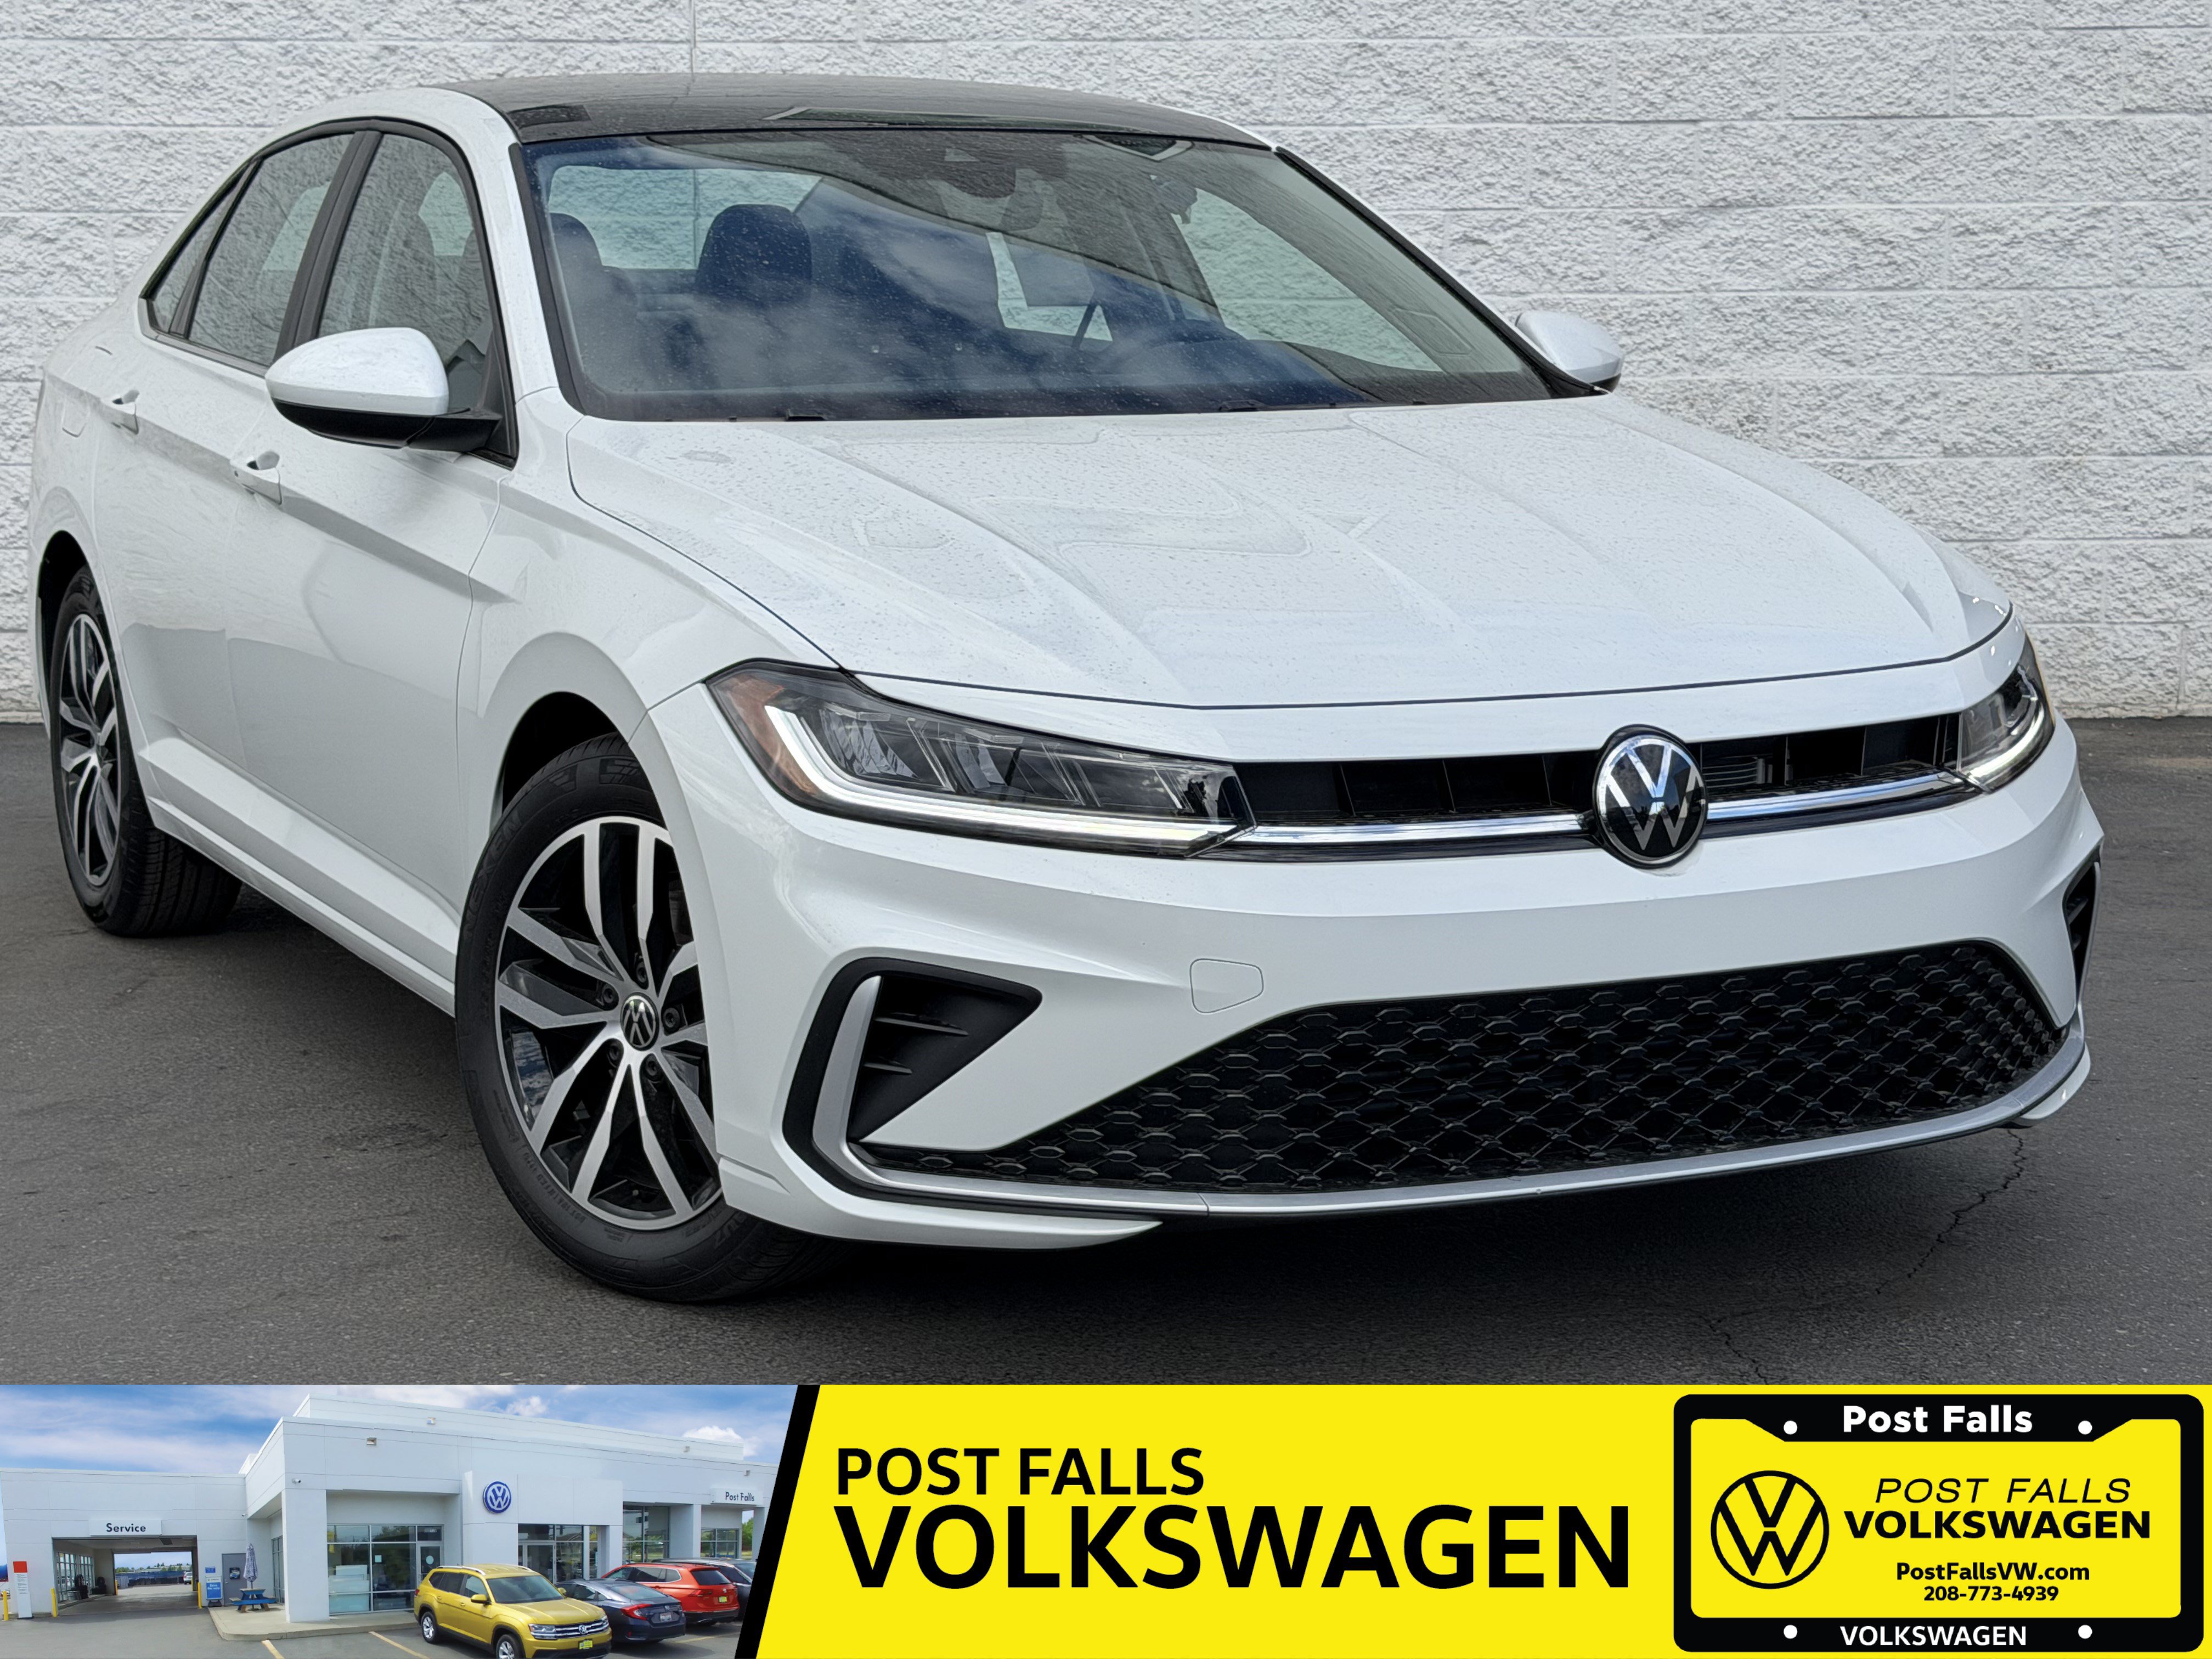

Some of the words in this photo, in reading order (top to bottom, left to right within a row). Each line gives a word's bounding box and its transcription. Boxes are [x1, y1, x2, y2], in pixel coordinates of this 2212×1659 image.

[1596, 733, 1705, 864] VW
[463, 809, 522, 939] NEXEN
[483, 1481, 511, 1513] VW
[725, 1492, 738, 1500] Post
[741, 1493, 755, 1502] Falls
[106, 1523, 146, 1532] Service
